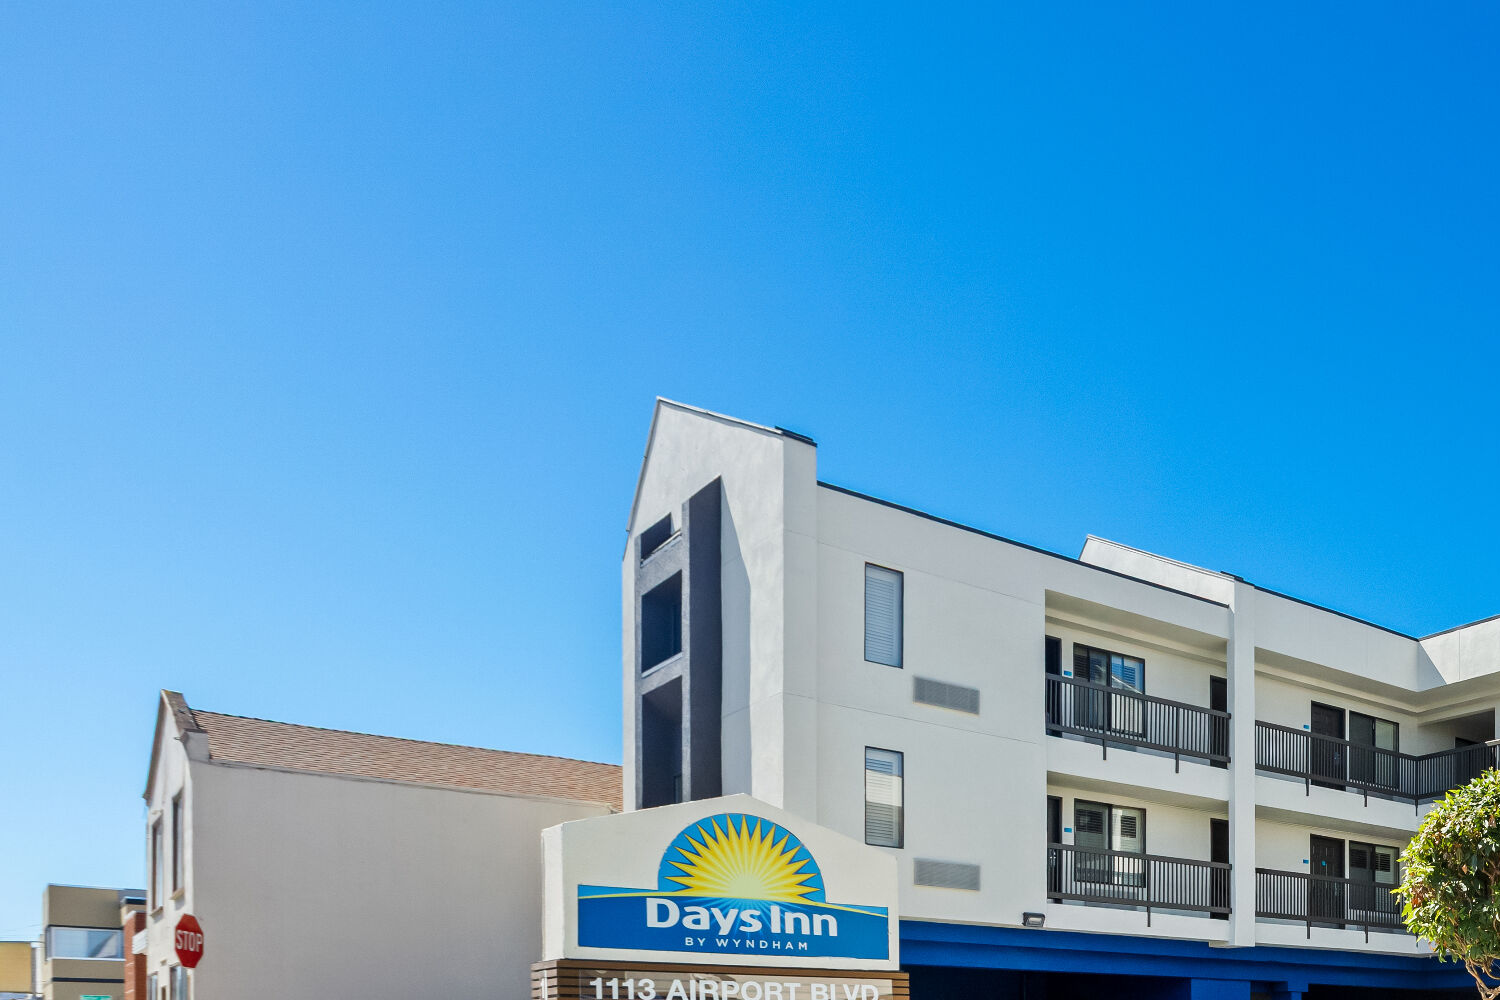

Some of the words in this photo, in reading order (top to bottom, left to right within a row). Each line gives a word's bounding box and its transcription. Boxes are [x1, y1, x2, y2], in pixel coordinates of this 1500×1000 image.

[646, 897, 763, 936] Days
[770, 905, 838, 937] Inn
[176, 930, 203, 952] STOP
[684, 937, 706, 947] BY
[716, 938, 808, 951] WYNDHAM
[589, 977, 657, 1000] 1113
